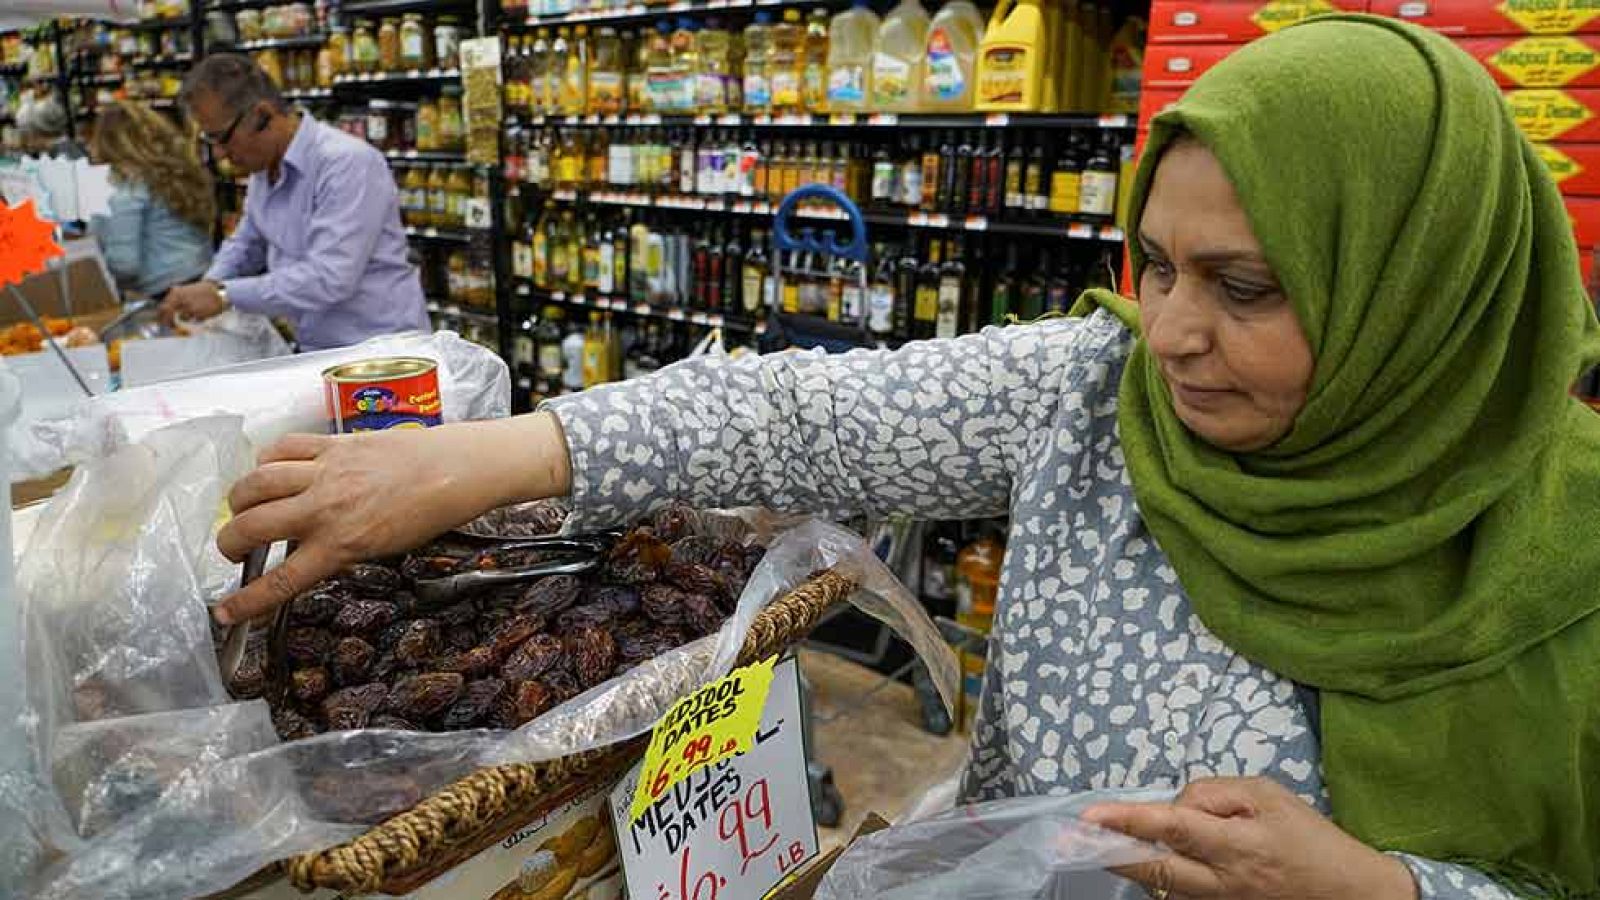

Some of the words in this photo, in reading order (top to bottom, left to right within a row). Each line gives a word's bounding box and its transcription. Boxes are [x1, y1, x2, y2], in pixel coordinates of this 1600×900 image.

[662, 697, 738, 755] DATES
[657, 777, 780, 900] 6.99
[776, 839, 805, 873] LB
[665, 769, 742, 855] DATES
